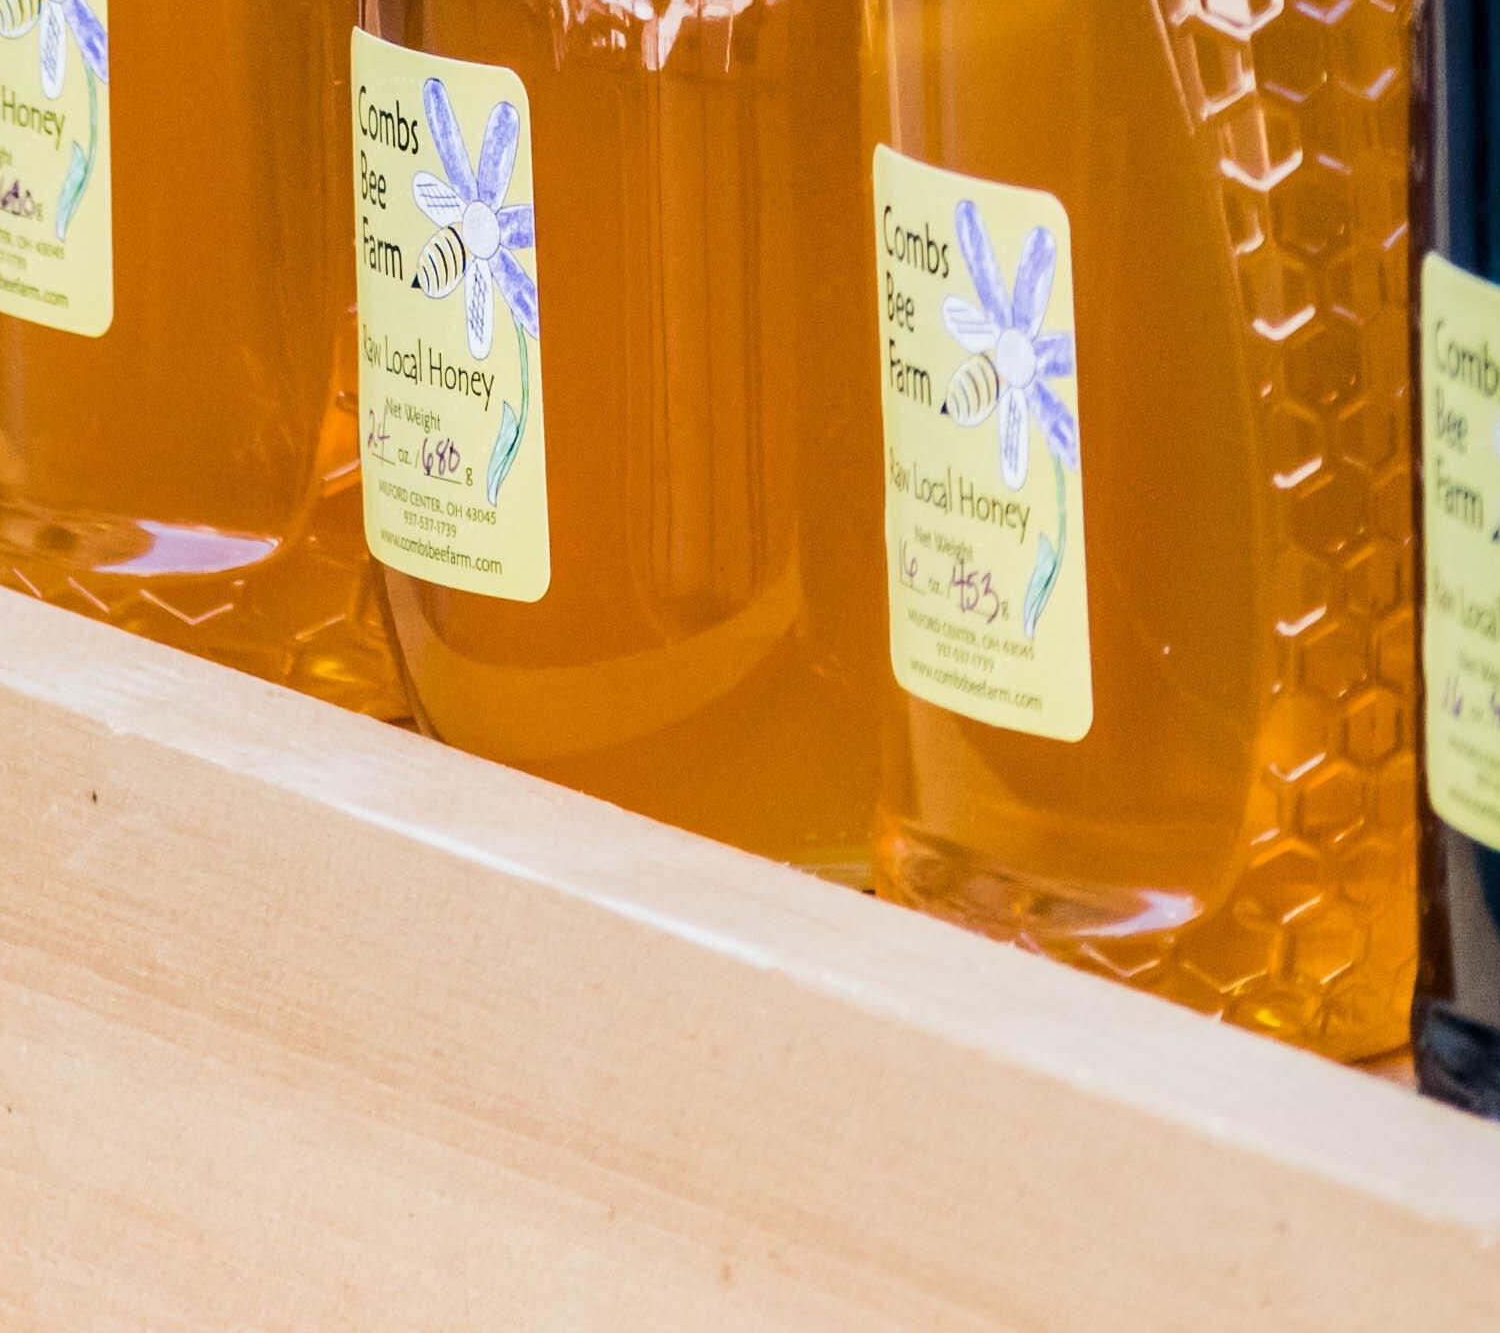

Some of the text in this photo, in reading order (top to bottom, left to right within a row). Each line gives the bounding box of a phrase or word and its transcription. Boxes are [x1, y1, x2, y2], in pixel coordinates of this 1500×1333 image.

[2, 85, 66, 151] Honey
[359, 85, 419, 155] Combs
[360, 150, 386, 210] Bee
[363, 216, 403, 281] Farm
[883, 205, 949, 278] Combs
[887, 271, 914, 333] Bee
[363, 324, 495, 412] Raw Local Honey
[889, 338, 931, 408] Farm
[385, 397, 440, 434] Net Weight
[1436, 385, 1468, 455] Bee
[378, 478, 408, 503] MILFORD
[446, 502, 463, 519] OH
[465, 506, 497, 525] 43045
[465, 467, 473, 486] g
[913, 462, 952, 515] Local
[959, 476, 1031, 544] Honey
[1437, 456, 1484, 531] Farm
[380, 529, 503, 574] www.combsbeefarm.com
[951, 558, 1000, 624] 453
